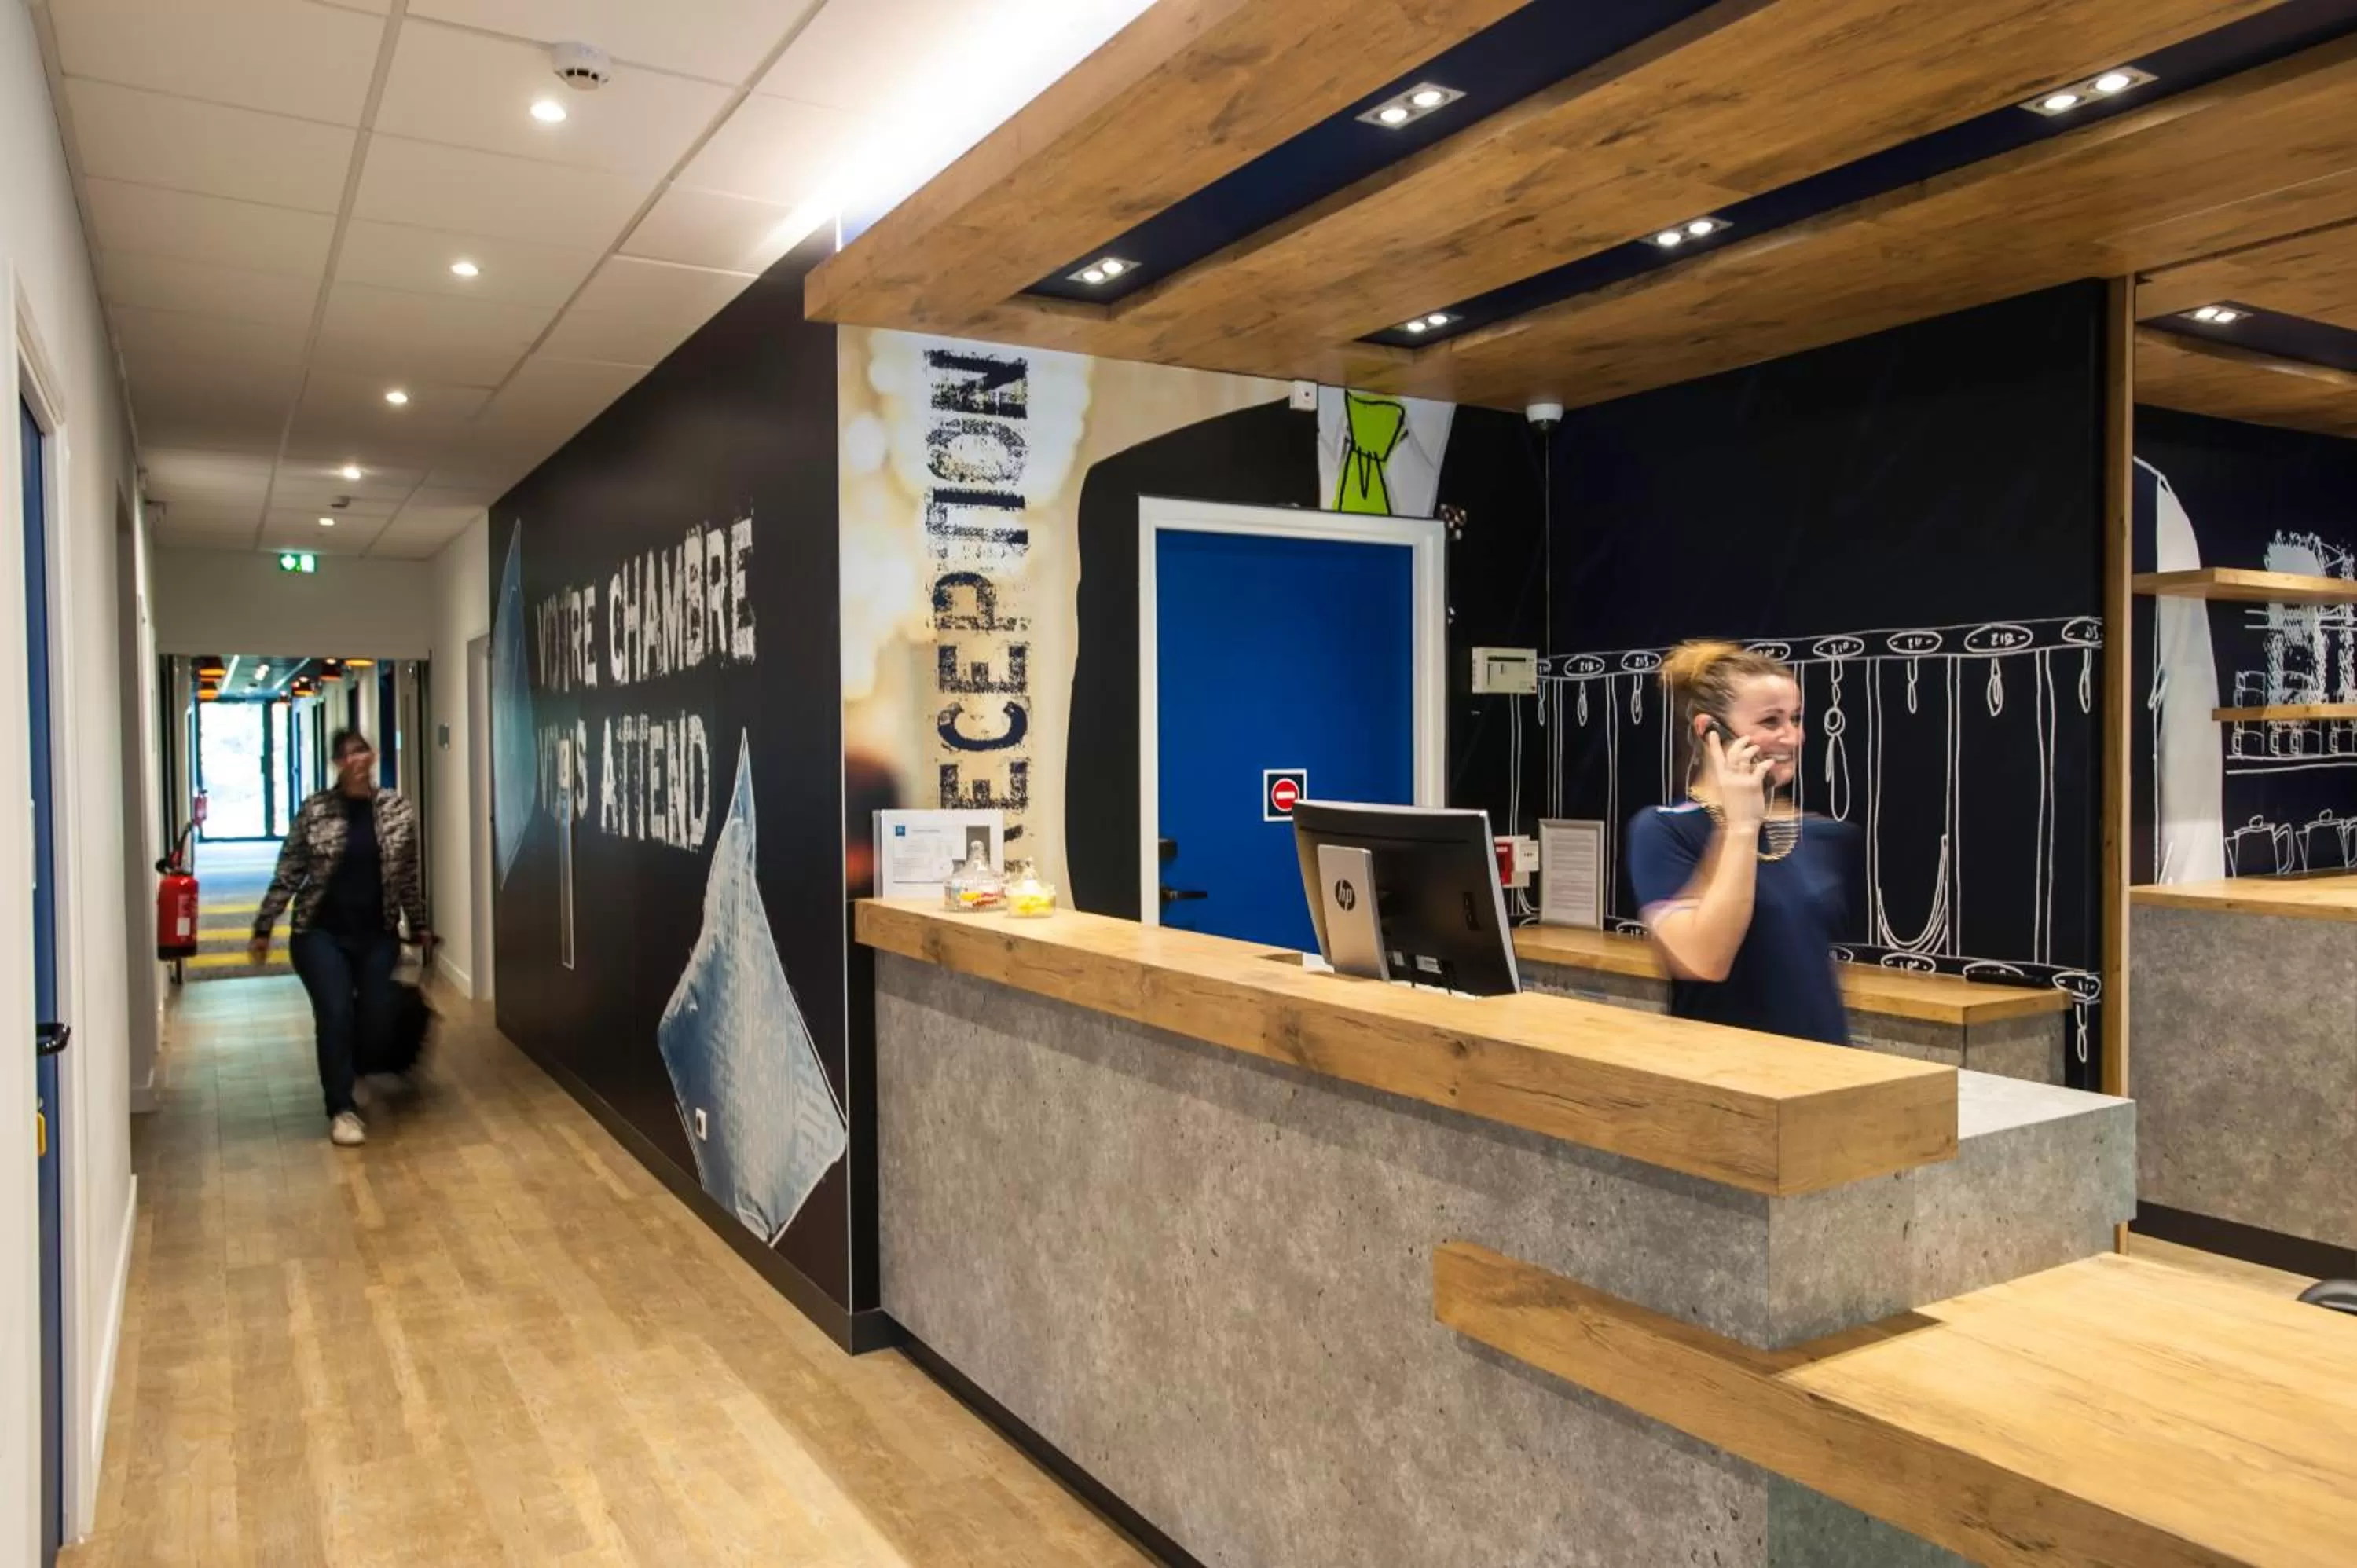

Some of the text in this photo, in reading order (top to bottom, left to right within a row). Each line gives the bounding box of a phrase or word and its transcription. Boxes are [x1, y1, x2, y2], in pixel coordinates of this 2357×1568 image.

[537, 516, 757, 692] VOTRE CHAMBRE
[600, 710, 710, 854] ATTEND
[1337, 879, 1355, 911] hp
